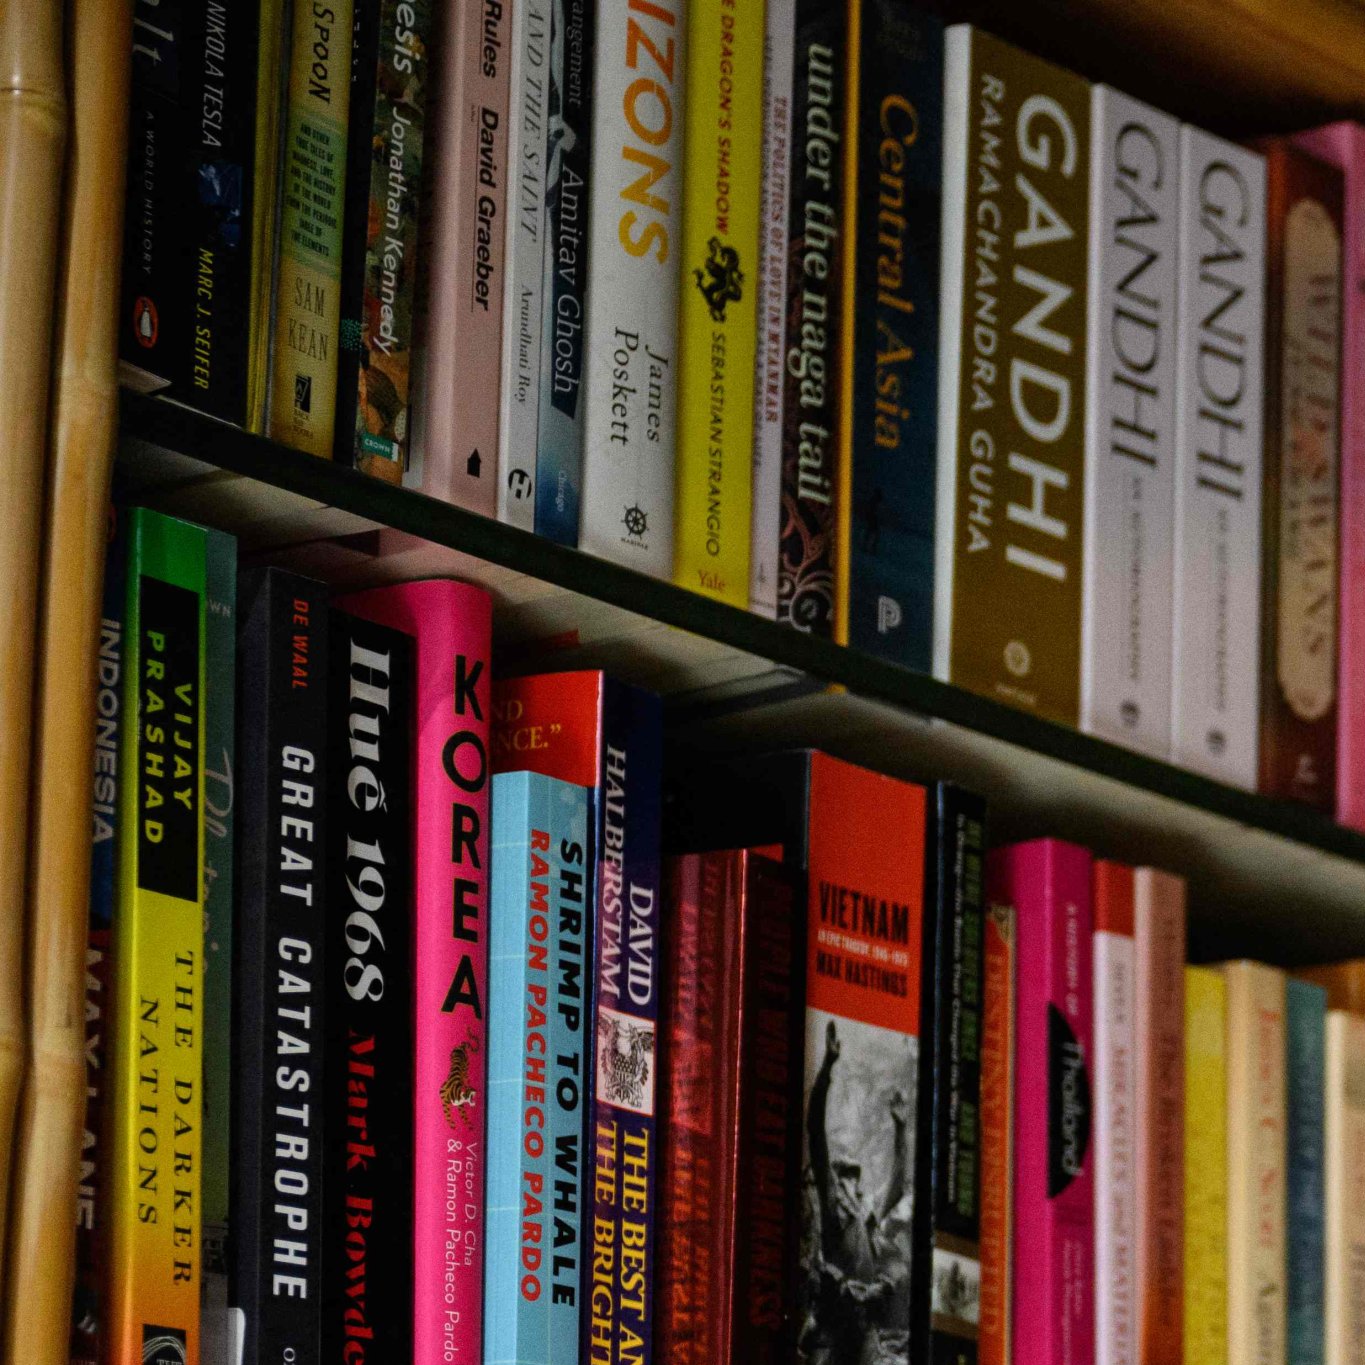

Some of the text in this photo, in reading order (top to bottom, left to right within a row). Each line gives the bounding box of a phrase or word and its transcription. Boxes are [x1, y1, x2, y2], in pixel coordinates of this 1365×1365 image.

[202, 0, 227, 147] NIKOLA TESLA
[520, 8, 545, 243] AND THE SAINT
[373, 106, 411, 358] Jonathan Kennedy
[474, 107, 499, 311] David Graeber
[553, 164, 585, 394] Amitav Ghosh
[715, 139, 732, 235] SHADOW
[788, 43, 838, 507] under the naga tail
[874, 93, 919, 448] Central Asia
[192, 248, 216, 390] MARC J. SEIFER
[286, 318, 328, 360] KEAN
[294, 277, 325, 317] SAM
[517, 284, 532, 405] Arundhati Roy
[611, 327, 639, 446] Poskett
[645, 345, 669, 443] James
[967, 73, 1005, 553] RAMACHANDRA GUHA
[1005, 92, 1078, 583] GANDHI
[1111, 123, 1162, 468] GANDHI
[1195, 159, 1250, 499] GANDHI
[706, 332, 726, 557] SEBASTIAN STRANGIO
[92, 617, 122, 844] INDONESIA
[145, 629, 168, 845] PRASHAD
[173, 683, 193, 811] VIJAY
[291, 597, 310, 690] DE WAAL
[344, 833, 387, 1003] 1968
[441, 655, 488, 1020] KOREA
[599, 743, 627, 1000] HALBERSTAM
[627, 881, 654, 1006] DAVID
[818, 880, 909, 945] VIETNAM
[137, 995, 158, 1225] NATIONS
[172, 950, 193, 1285] THE DARKER
[272, 745, 315, 1300] GREAT CATASTROPHE
[345, 1028, 377, 1173] Mark
[520, 828, 550, 1302] RAMON PACHECO PARDO
[552, 838, 583, 1307] SHRIMP TO WHALE
[443, 1138, 462, 1362] & Ramon Pacheco Pardo
[463, 1141, 478, 1266] Victor D. Cha
[595, 1120, 618, 1207] THE
[618, 1219, 648, 1322] BEST
[620, 1127, 649, 1214] THE
